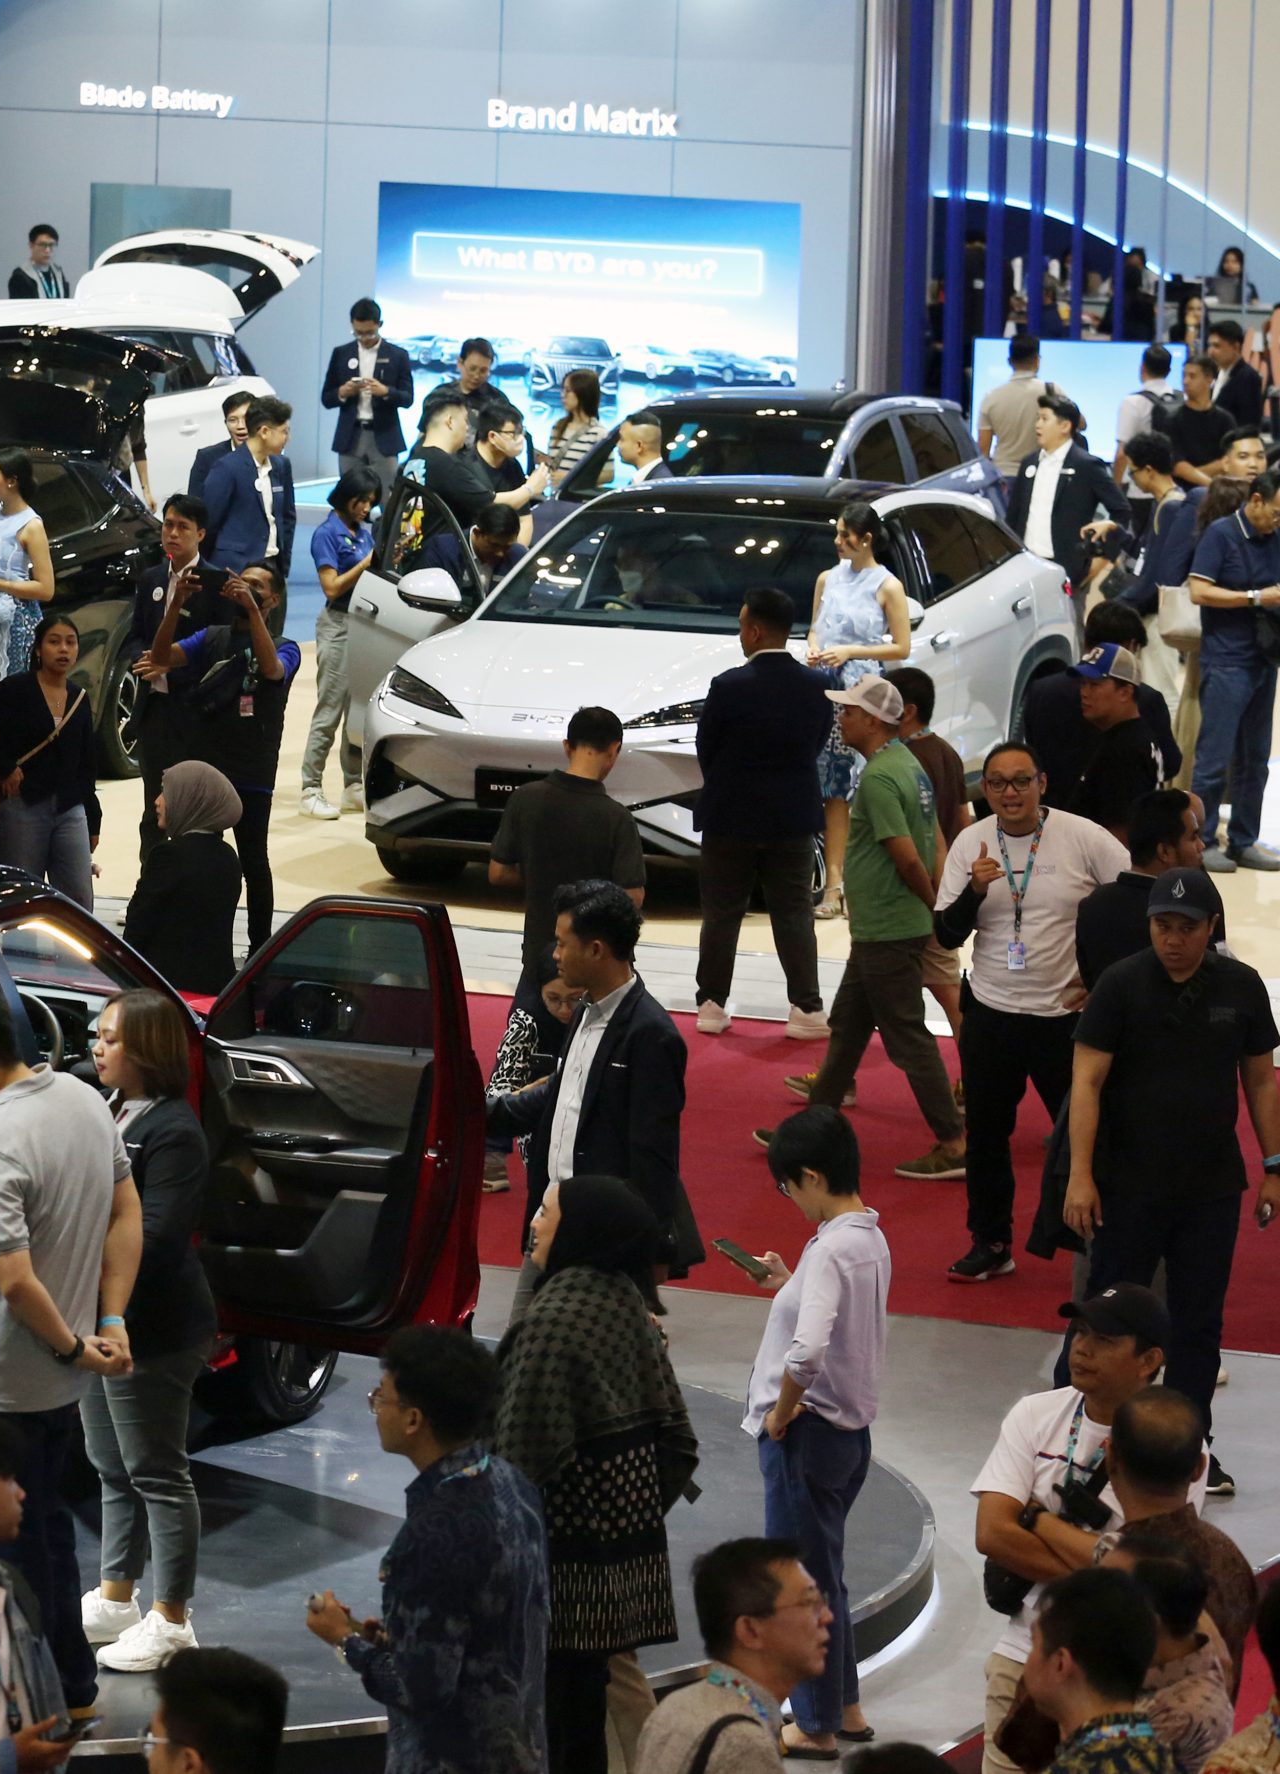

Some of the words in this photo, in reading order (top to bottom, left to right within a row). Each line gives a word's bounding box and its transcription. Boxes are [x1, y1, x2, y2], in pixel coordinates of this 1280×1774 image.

[80, 82, 146, 108] Blade
[151, 85, 233, 119] Battery
[487, 98, 577, 132] Brand
[583, 102, 677, 137] Matrix
[458, 246, 527, 270] What
[532, 250, 595, 274] BYD
[601, 256, 646, 277] are
[651, 258, 719, 283] you?
[511, 712, 564, 724] BYD
[490, 783, 513, 792] BYD
